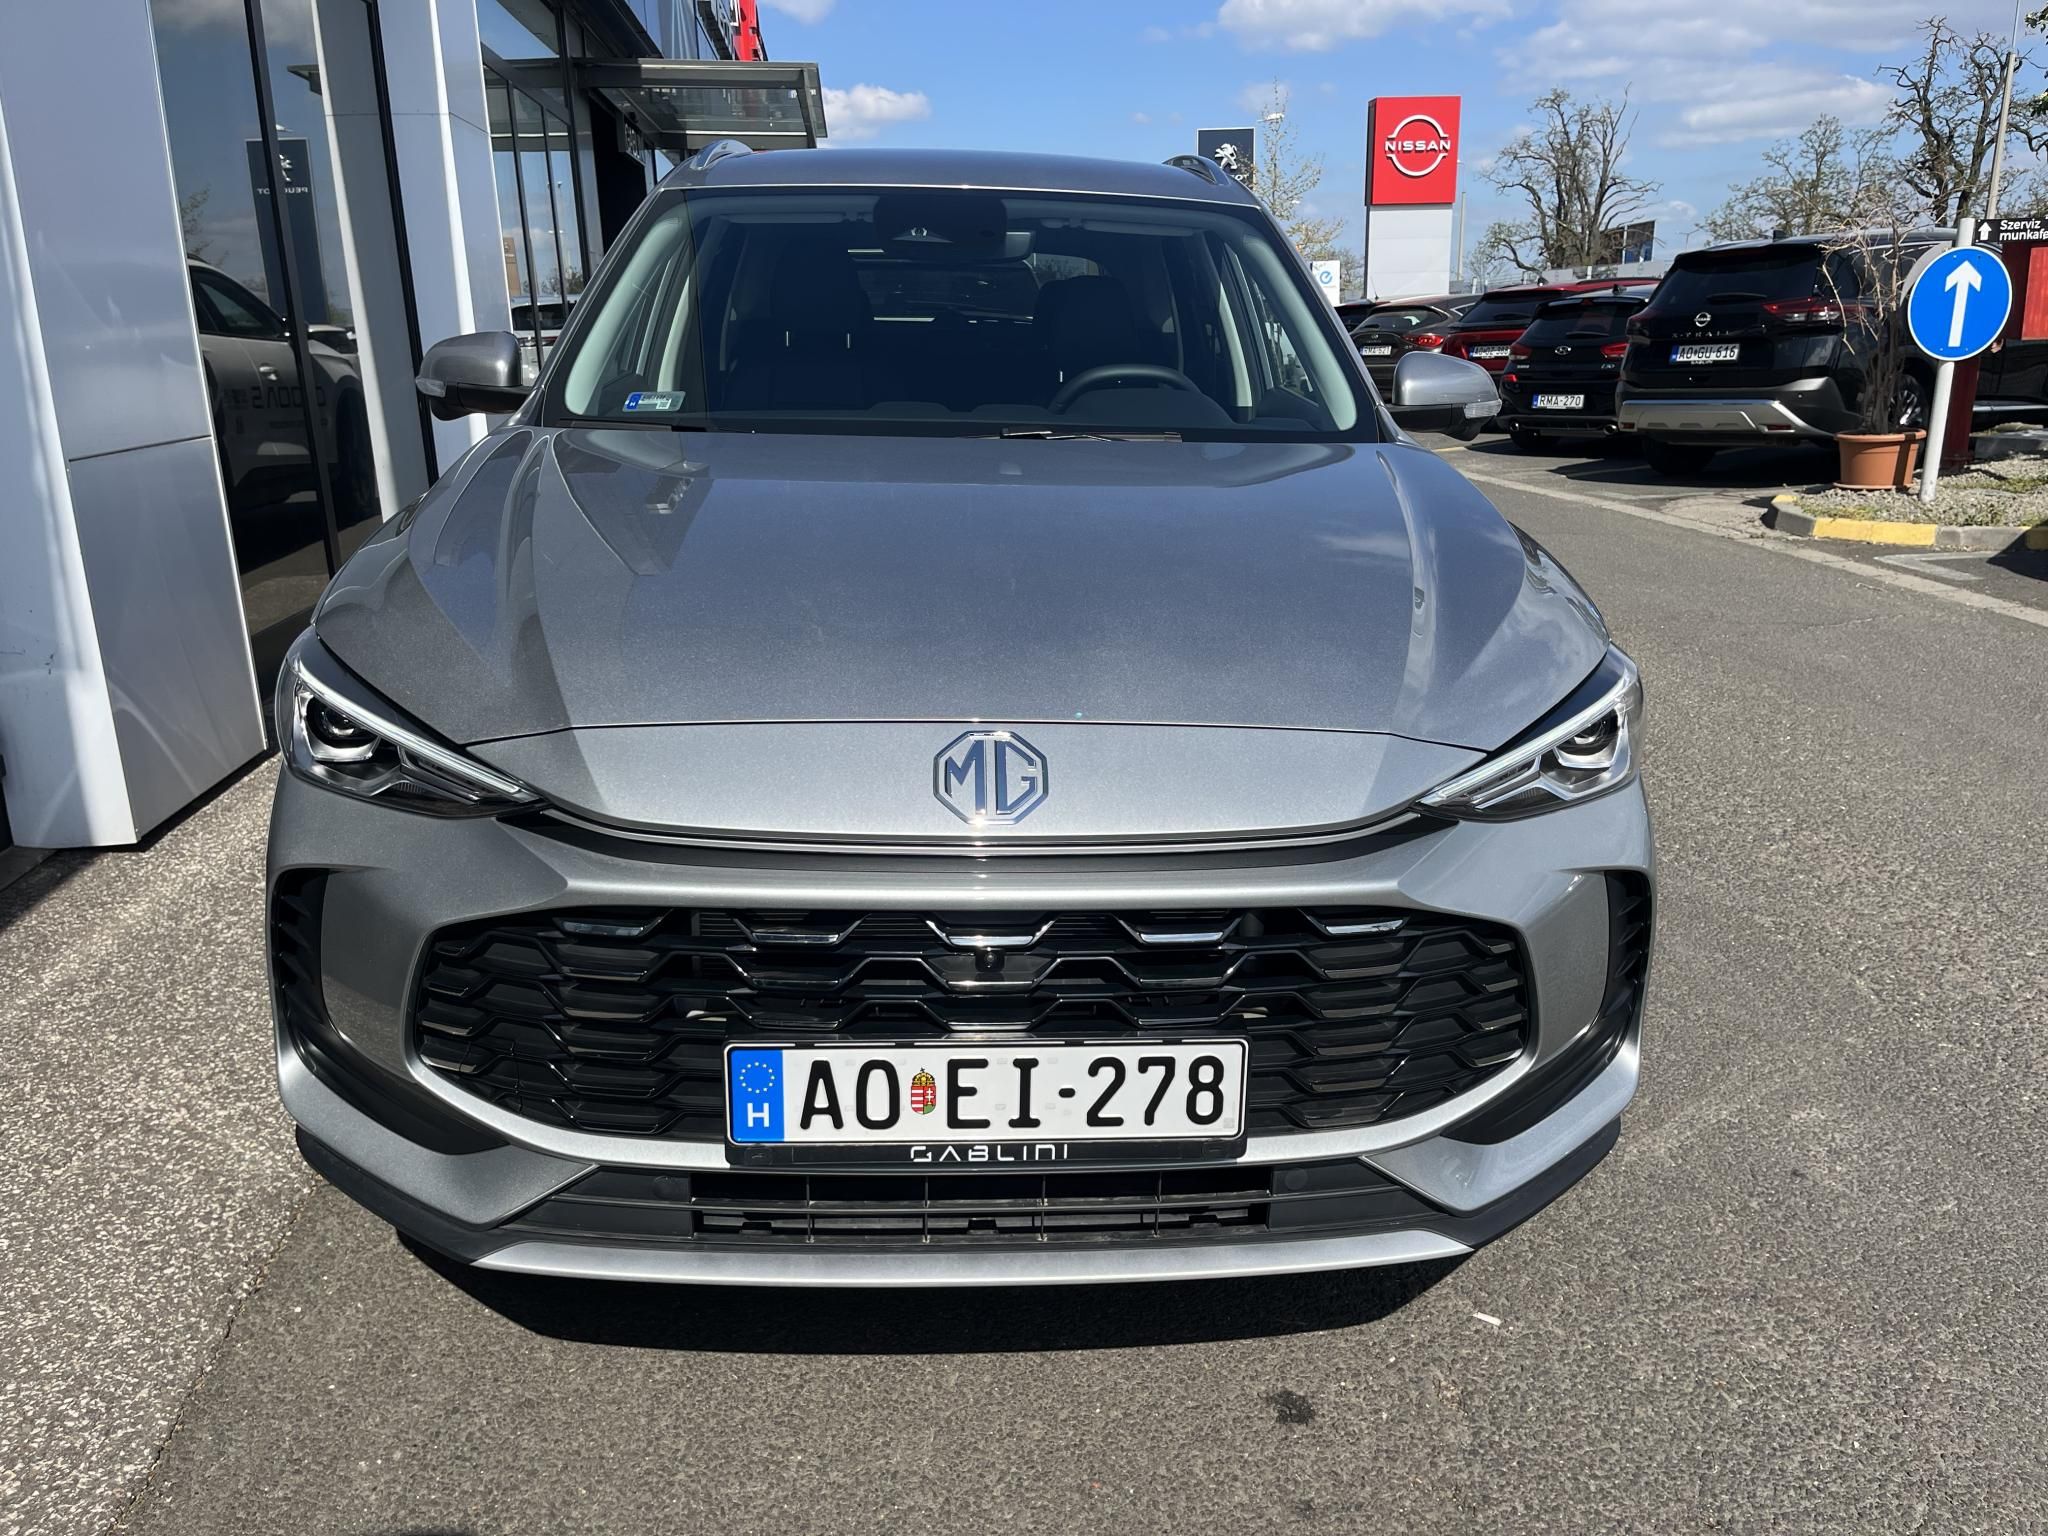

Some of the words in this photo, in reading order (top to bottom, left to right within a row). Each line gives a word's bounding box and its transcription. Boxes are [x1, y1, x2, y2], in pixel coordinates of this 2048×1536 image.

[1385, 140, 1451, 151] NISSAN
[2000, 219, 2041, 230] Szerviz
[1540, 395, 1581, 407] RMA-270
[945, 739, 1037, 815] MG
[799, 1058, 901, 1130] AO
[946, 1055, 1226, 1129] EI-278
[747, 1106, 770, 1128] H
[910, 1144, 1069, 1162] GABLINI
